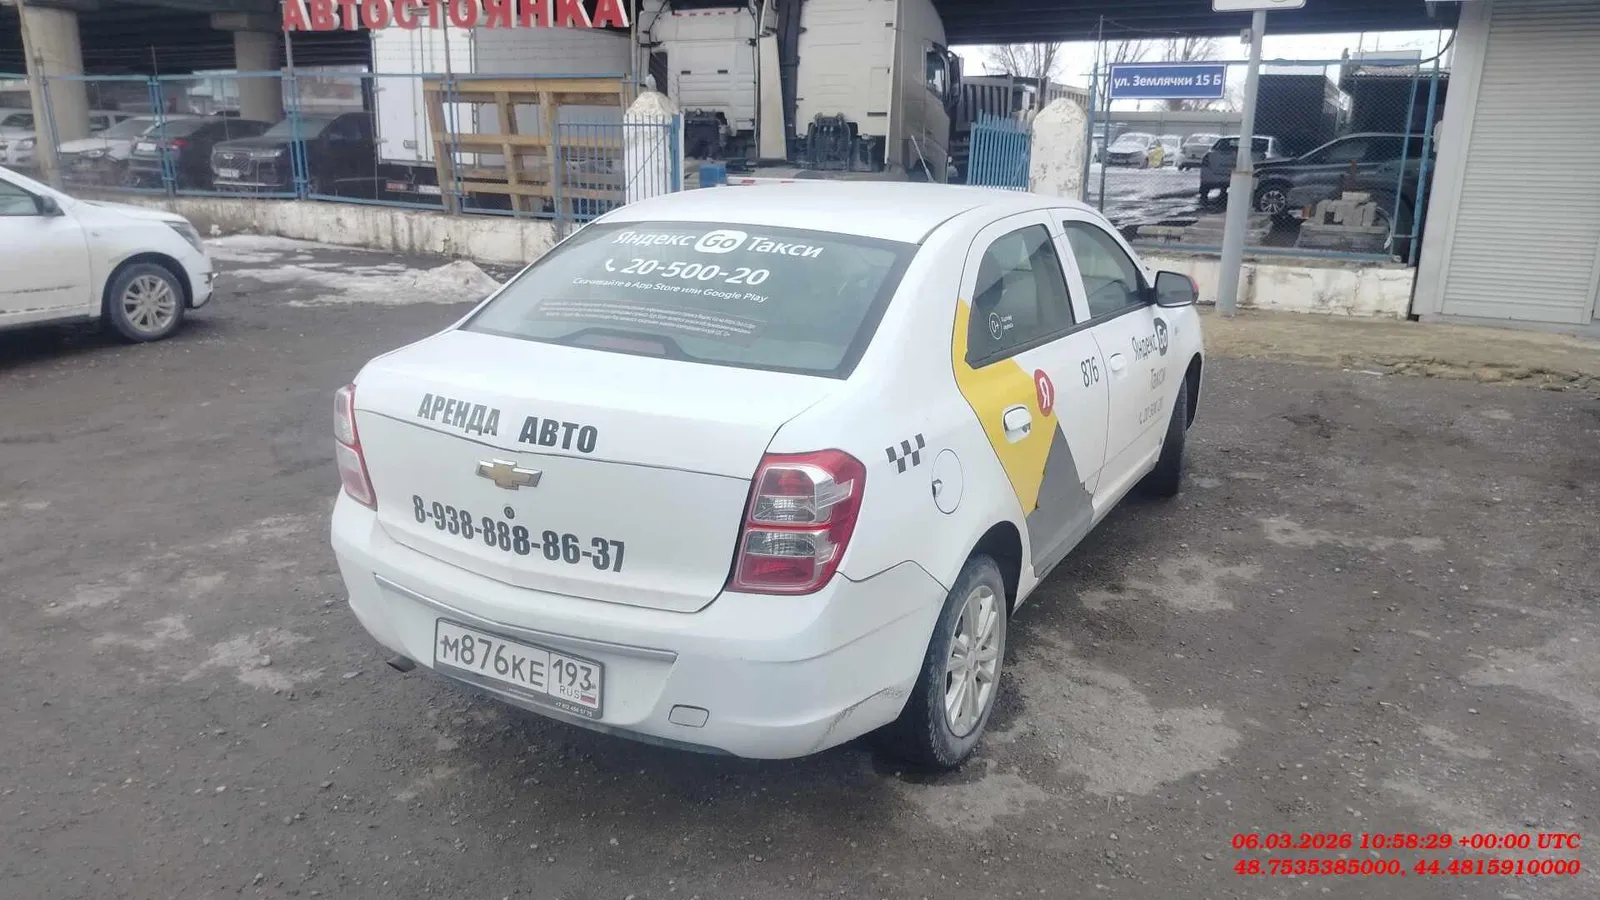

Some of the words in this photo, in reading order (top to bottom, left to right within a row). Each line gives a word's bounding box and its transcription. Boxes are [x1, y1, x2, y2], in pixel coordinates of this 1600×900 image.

[282, 0, 630, 31] АВТОСТОЯНКА
[1114, 77, 1130, 88] ул.
[1133, 75, 1192, 87] Землячки
[1196, 74, 1210, 86] 15
[1213, 74, 1221, 86] Б
[610, 230, 697, 247] Яндекс
[702, 233, 738, 249] Go
[746, 236, 825, 258] Такси
[620, 258, 770, 286] 20-500-20
[631, 280, 652, 291] App
[653, 282, 680, 293] Store
[681, 286, 701, 295] или
[703, 288, 741, 301] Google
[743, 292, 769, 303] Play
[1132, 334, 1158, 360] Яндекс
[1080, 357, 1099, 387] 876
[1040, 377, 1050, 408] Я
[417, 393, 500, 436] АРЕНДА
[518, 416, 598, 453] АВТО
[412, 495, 625, 573] 8-938-888-86-37
[441, 634, 544, 687] М876КЕ
[553, 658, 592, 691] 193
[559, 685, 580, 699] RUS
